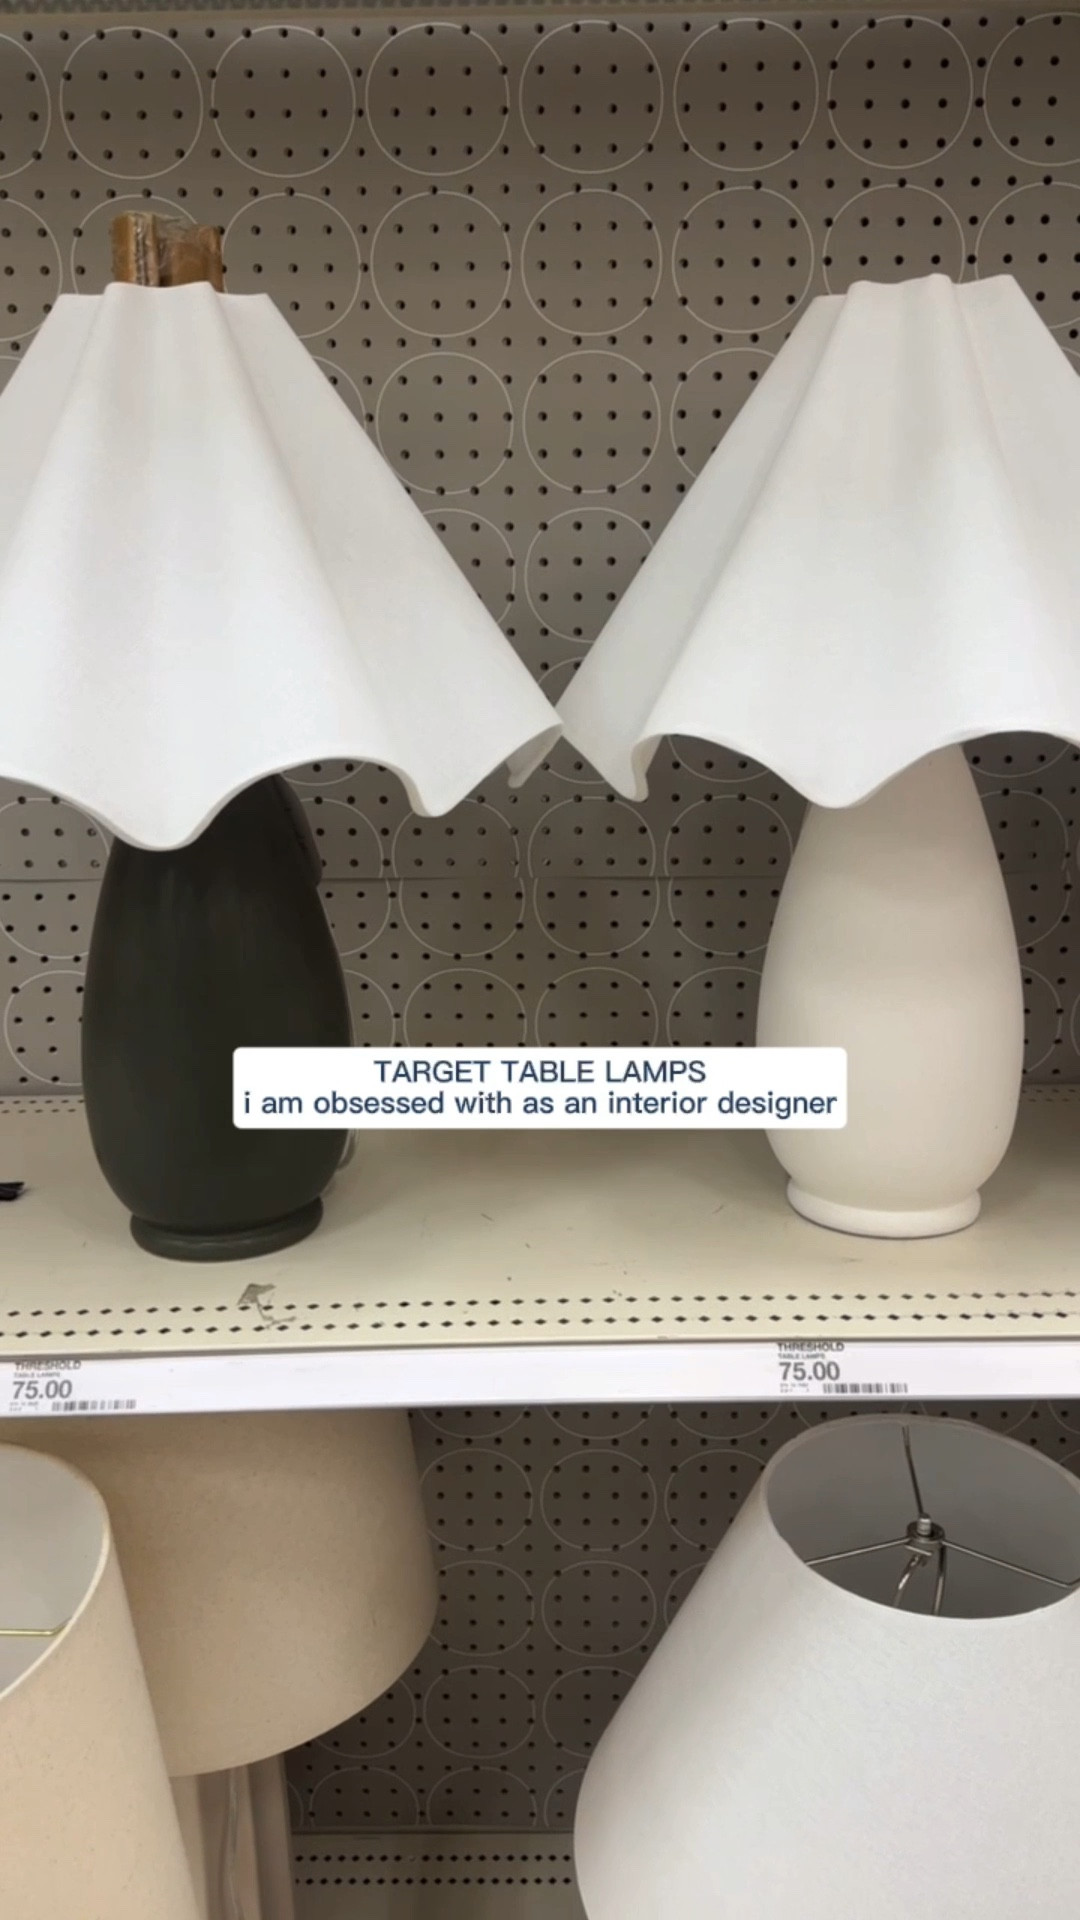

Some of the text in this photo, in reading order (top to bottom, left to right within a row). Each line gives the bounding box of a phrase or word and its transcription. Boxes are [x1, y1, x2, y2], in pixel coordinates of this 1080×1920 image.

[777, 1342, 845, 1352] THRESHOLD
[778, 1361, 841, 1381] 75.00
[12, 1379, 73, 1400] 75.00
